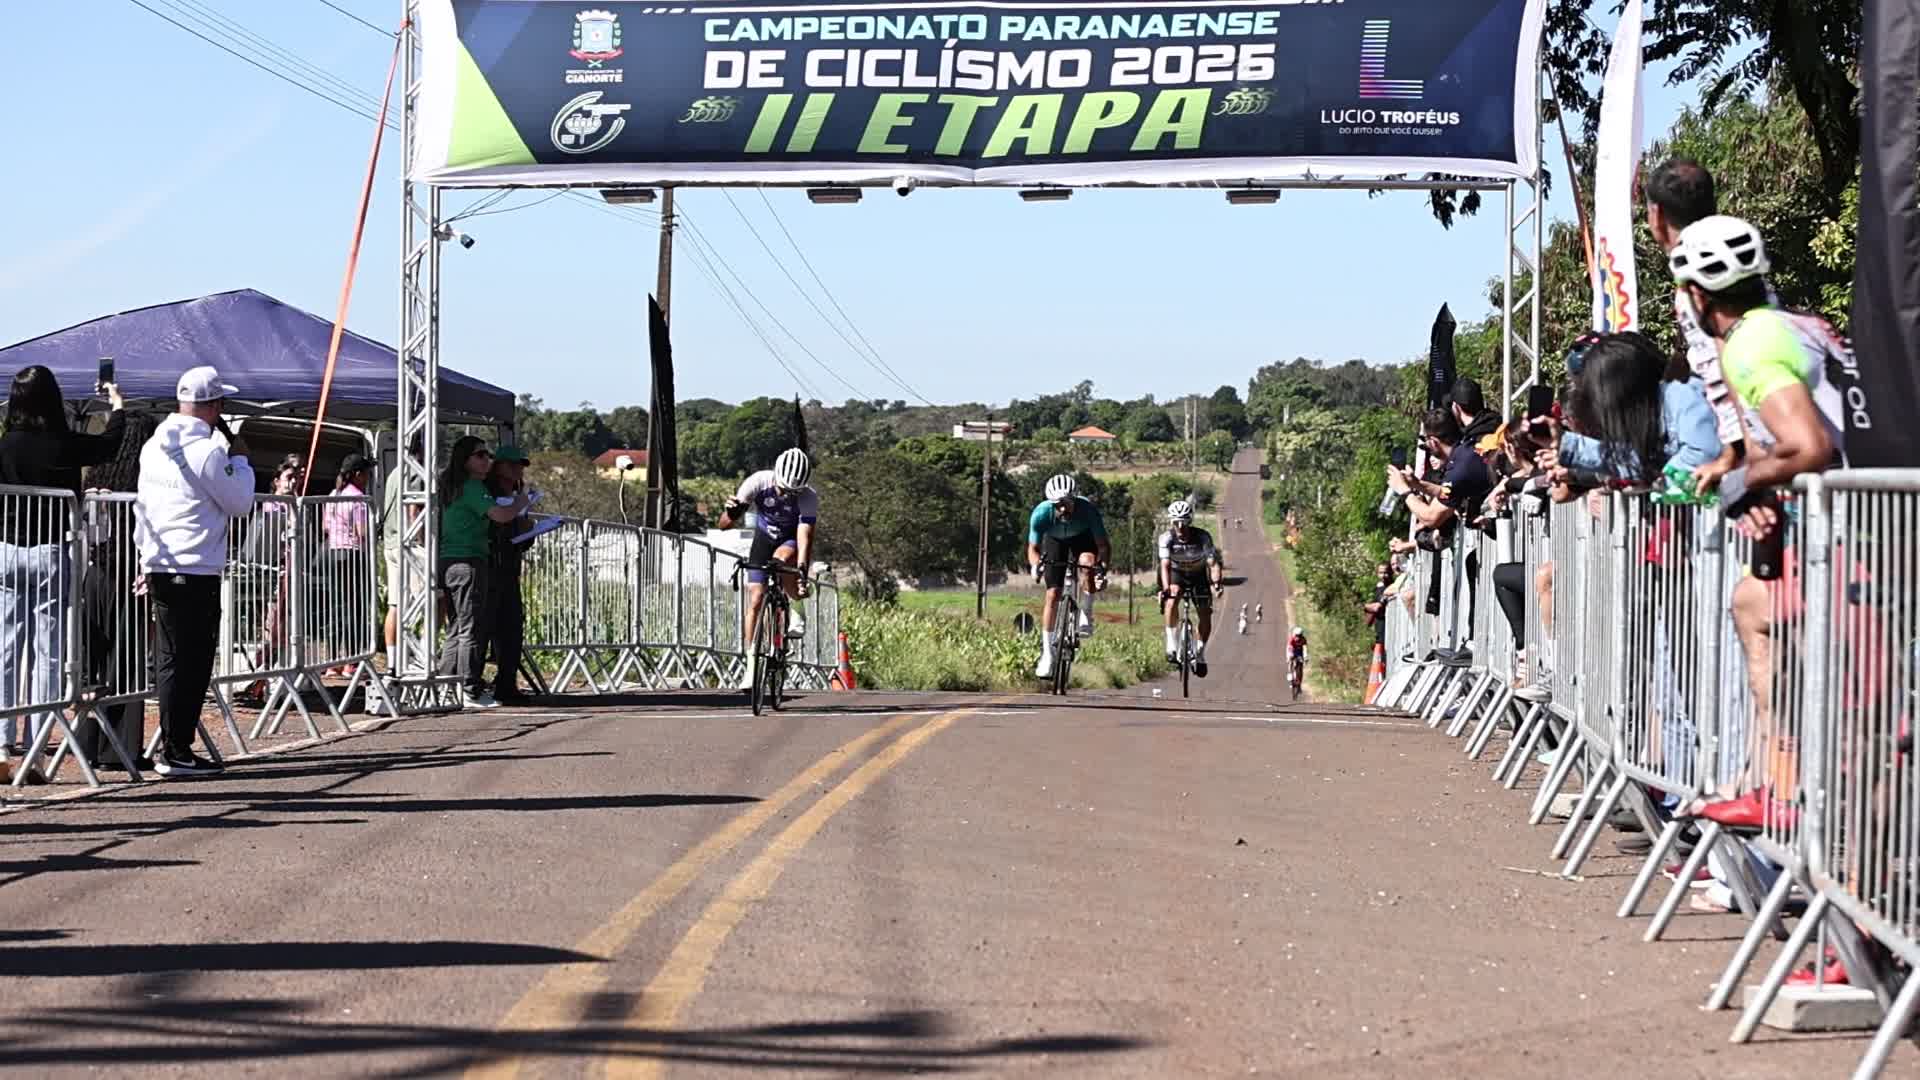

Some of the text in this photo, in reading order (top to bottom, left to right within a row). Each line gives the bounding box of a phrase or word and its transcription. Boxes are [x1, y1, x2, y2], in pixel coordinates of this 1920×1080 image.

[705, 11, 1281, 42] CAMPEONATO PARANAENSE
[565, 74, 623, 83] CIANORTE
[703, 38, 1276, 90] DE CICLÍSMO 2026
[743, 88, 1213, 158] II ETAPA
[1321, 108, 1460, 125] LUCIO TROFÉUS
[1338, 127, 1352, 135] DO
[1374, 127, 1390, 135] QUE
[1847, 386, 1872, 429] DO
